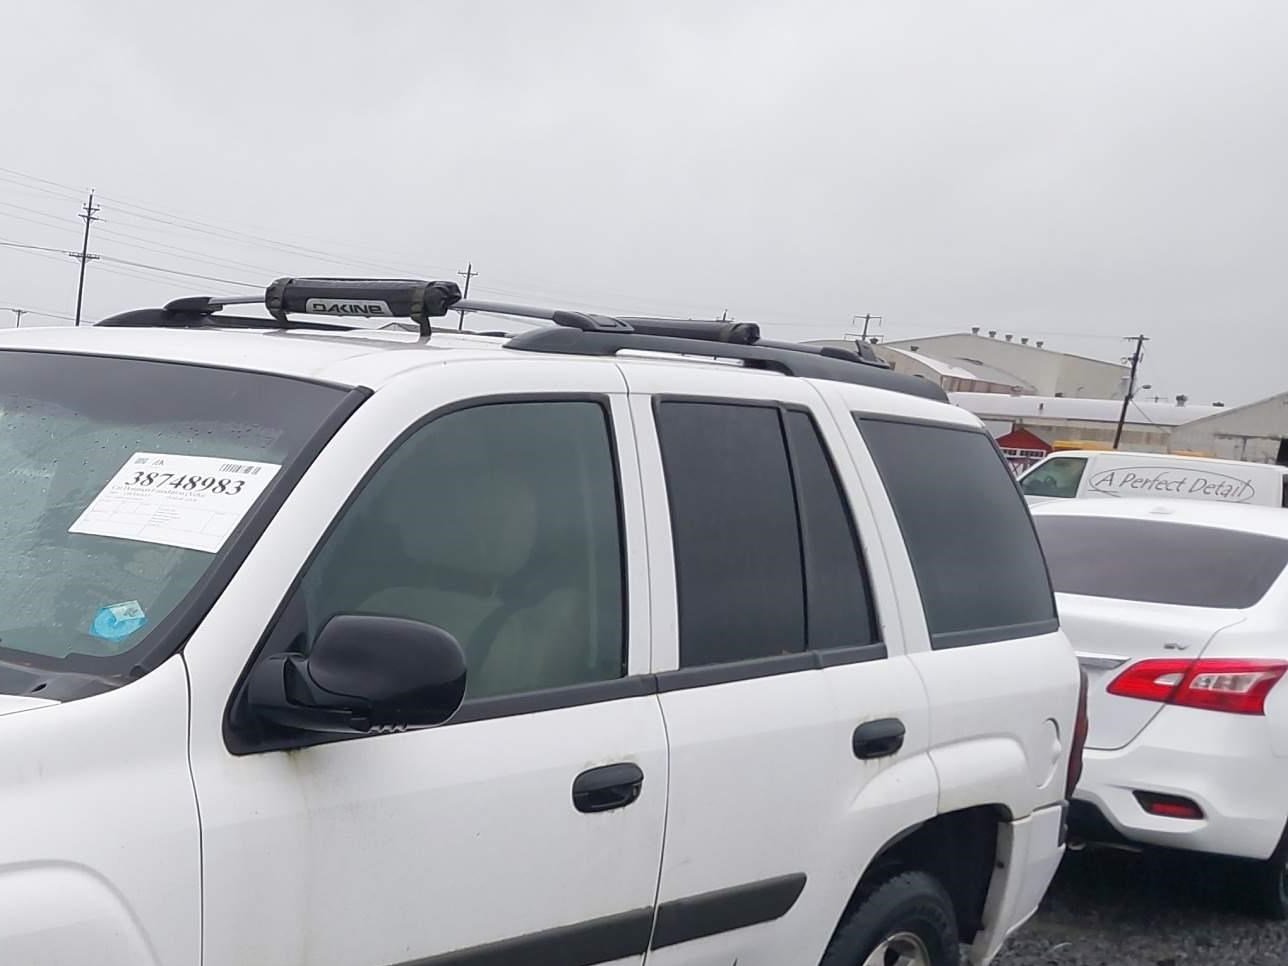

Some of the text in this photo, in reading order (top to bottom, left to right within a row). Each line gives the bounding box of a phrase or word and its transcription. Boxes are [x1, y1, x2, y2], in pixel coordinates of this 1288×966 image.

[312, 303, 385, 315] DAKINE
[124, 471, 246, 496] 38748983
[1095, 471, 1252, 499] A Perfect Detail
